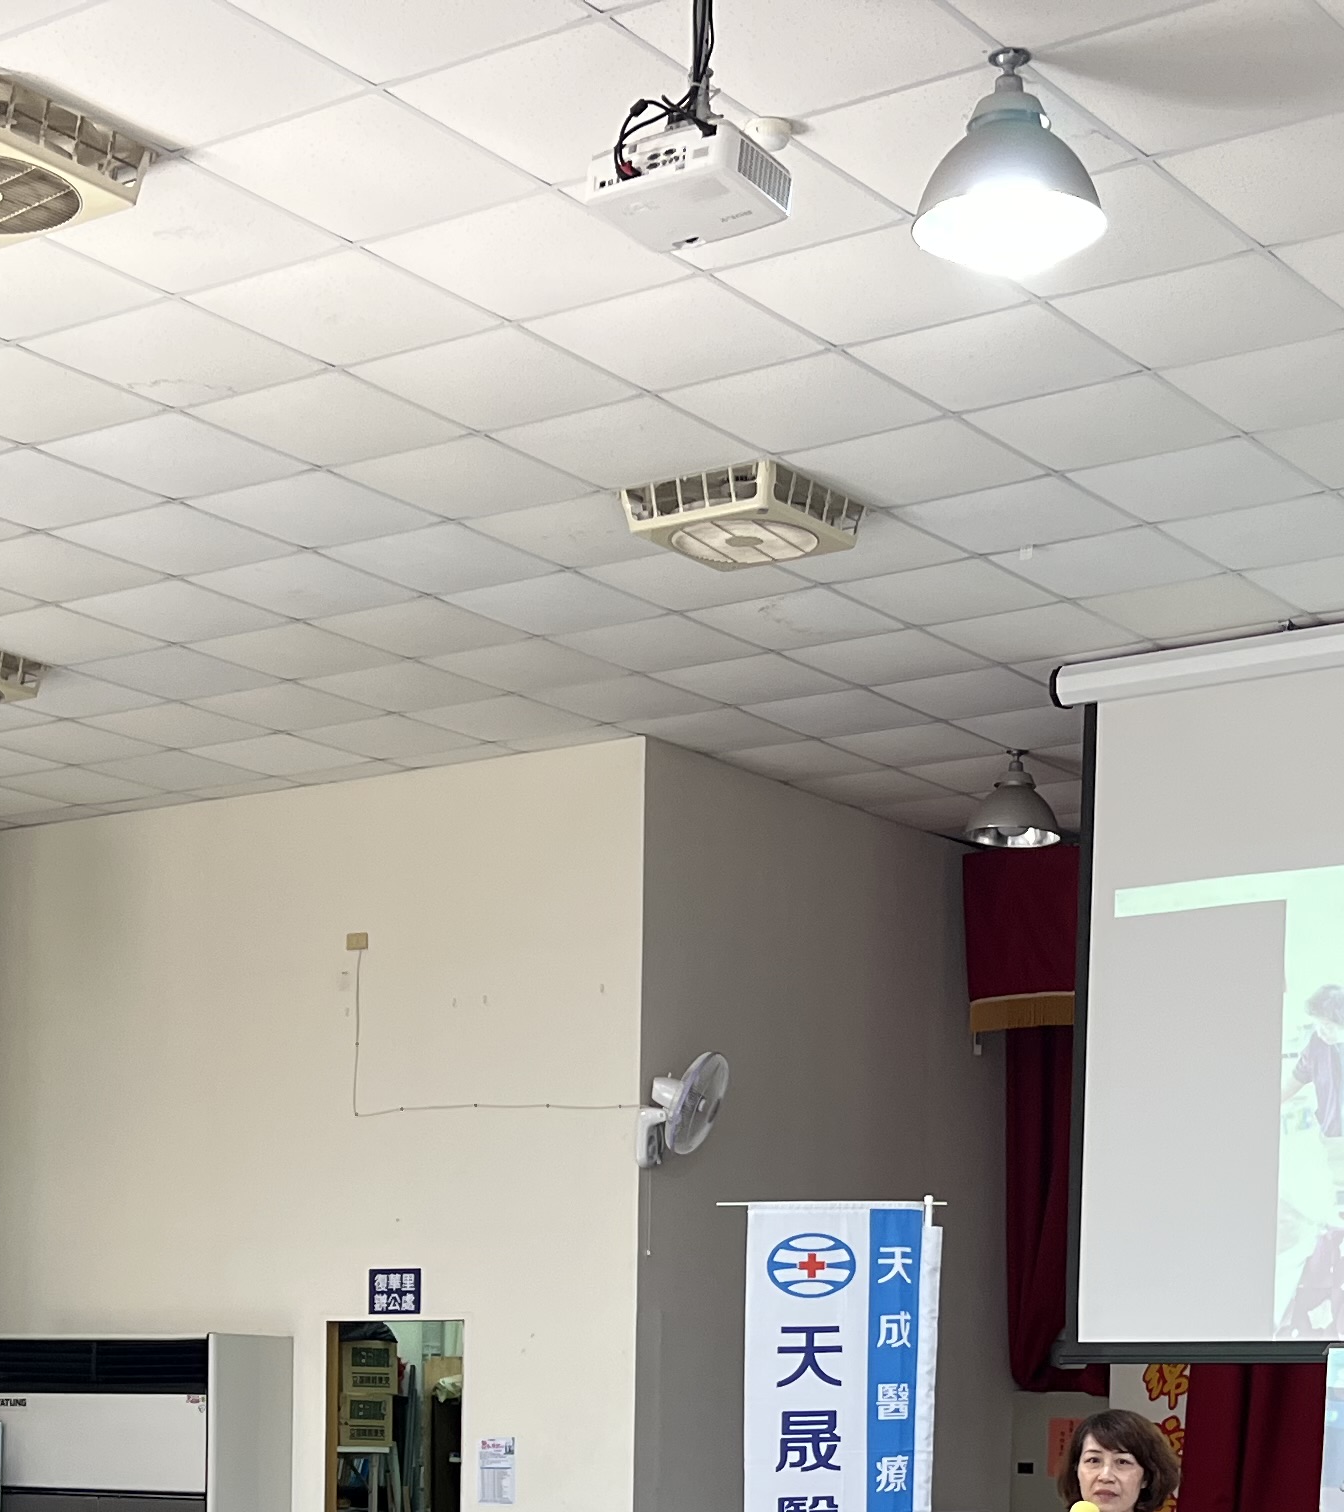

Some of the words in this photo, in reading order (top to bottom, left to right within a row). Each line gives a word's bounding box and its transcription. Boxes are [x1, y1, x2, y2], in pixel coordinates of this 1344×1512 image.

[374, 1273, 415, 1292] 復華里
[374, 1293, 415, 1311] 辦公處
